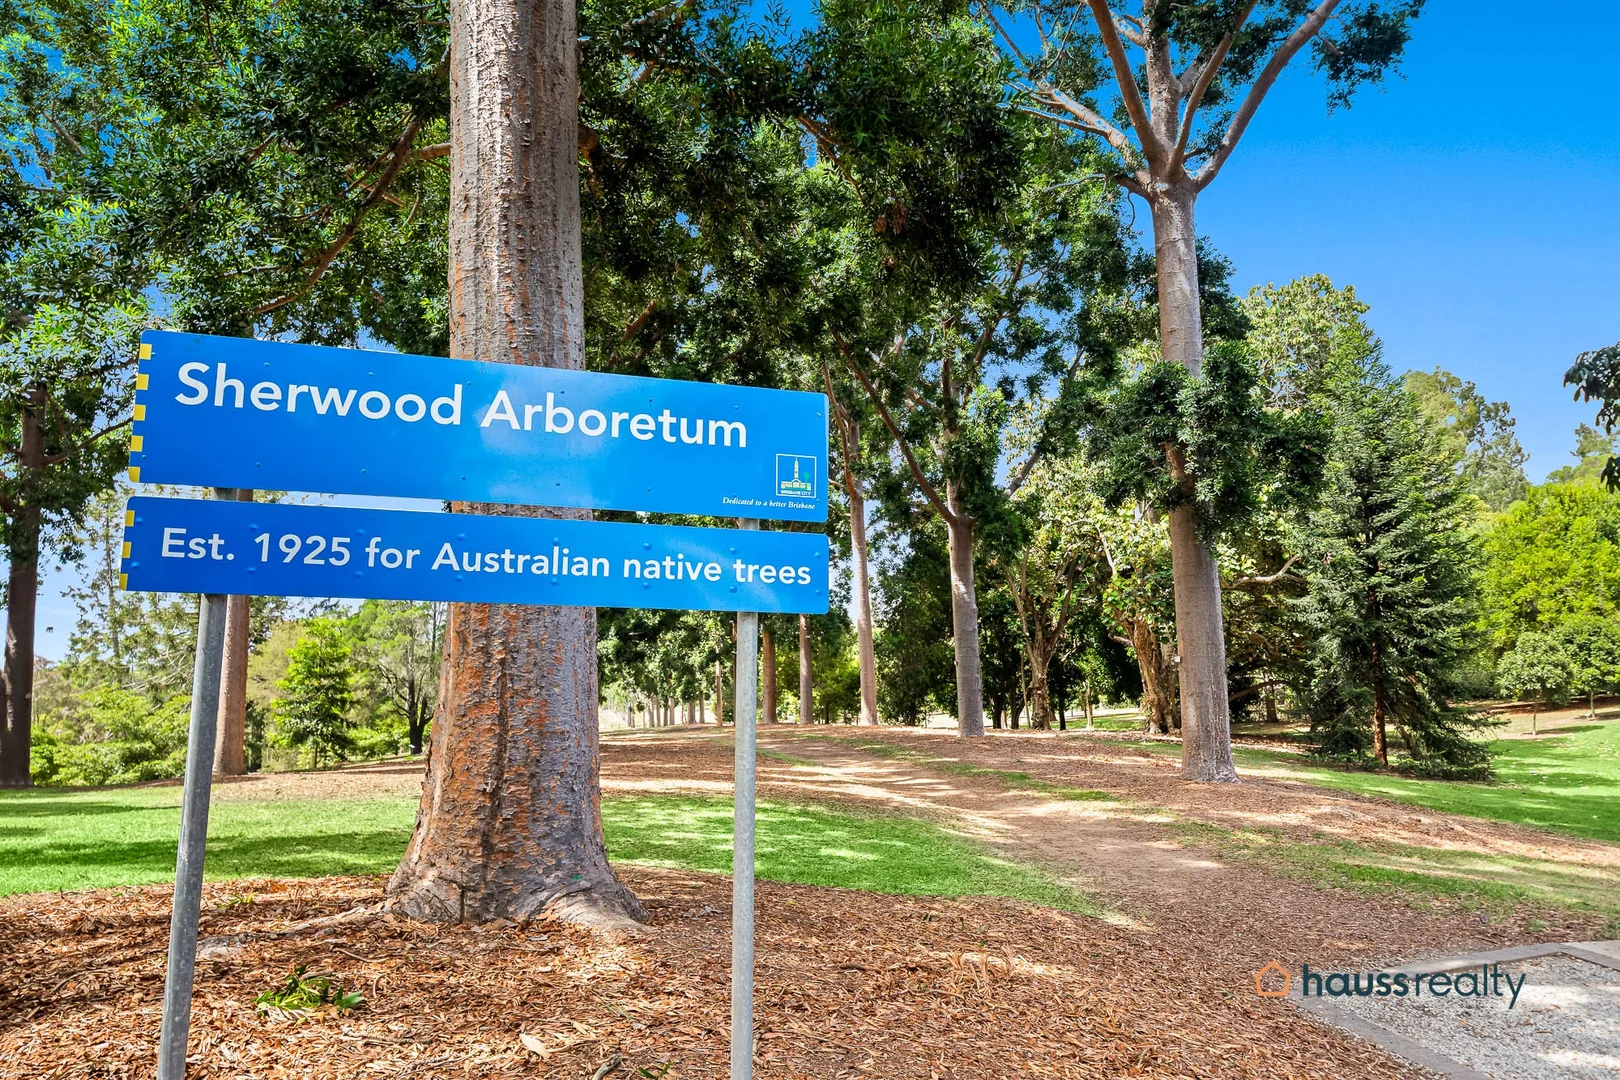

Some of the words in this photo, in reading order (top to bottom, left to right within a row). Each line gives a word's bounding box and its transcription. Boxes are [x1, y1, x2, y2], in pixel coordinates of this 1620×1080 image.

[174, 361, 463, 426] Sherwood
[480, 389, 747, 448] Arboretum
[722, 497, 754, 506] Dedicated
[769, 500, 786, 509] better
[788, 501, 815, 510] Brisbane
[161, 527, 235, 560] Est.
[254, 532, 351, 567] 1925
[365, 537, 421, 569] for
[431, 543, 610, 577] Australian
[623, 553, 722, 582] native
[732, 559, 812, 585] trees
